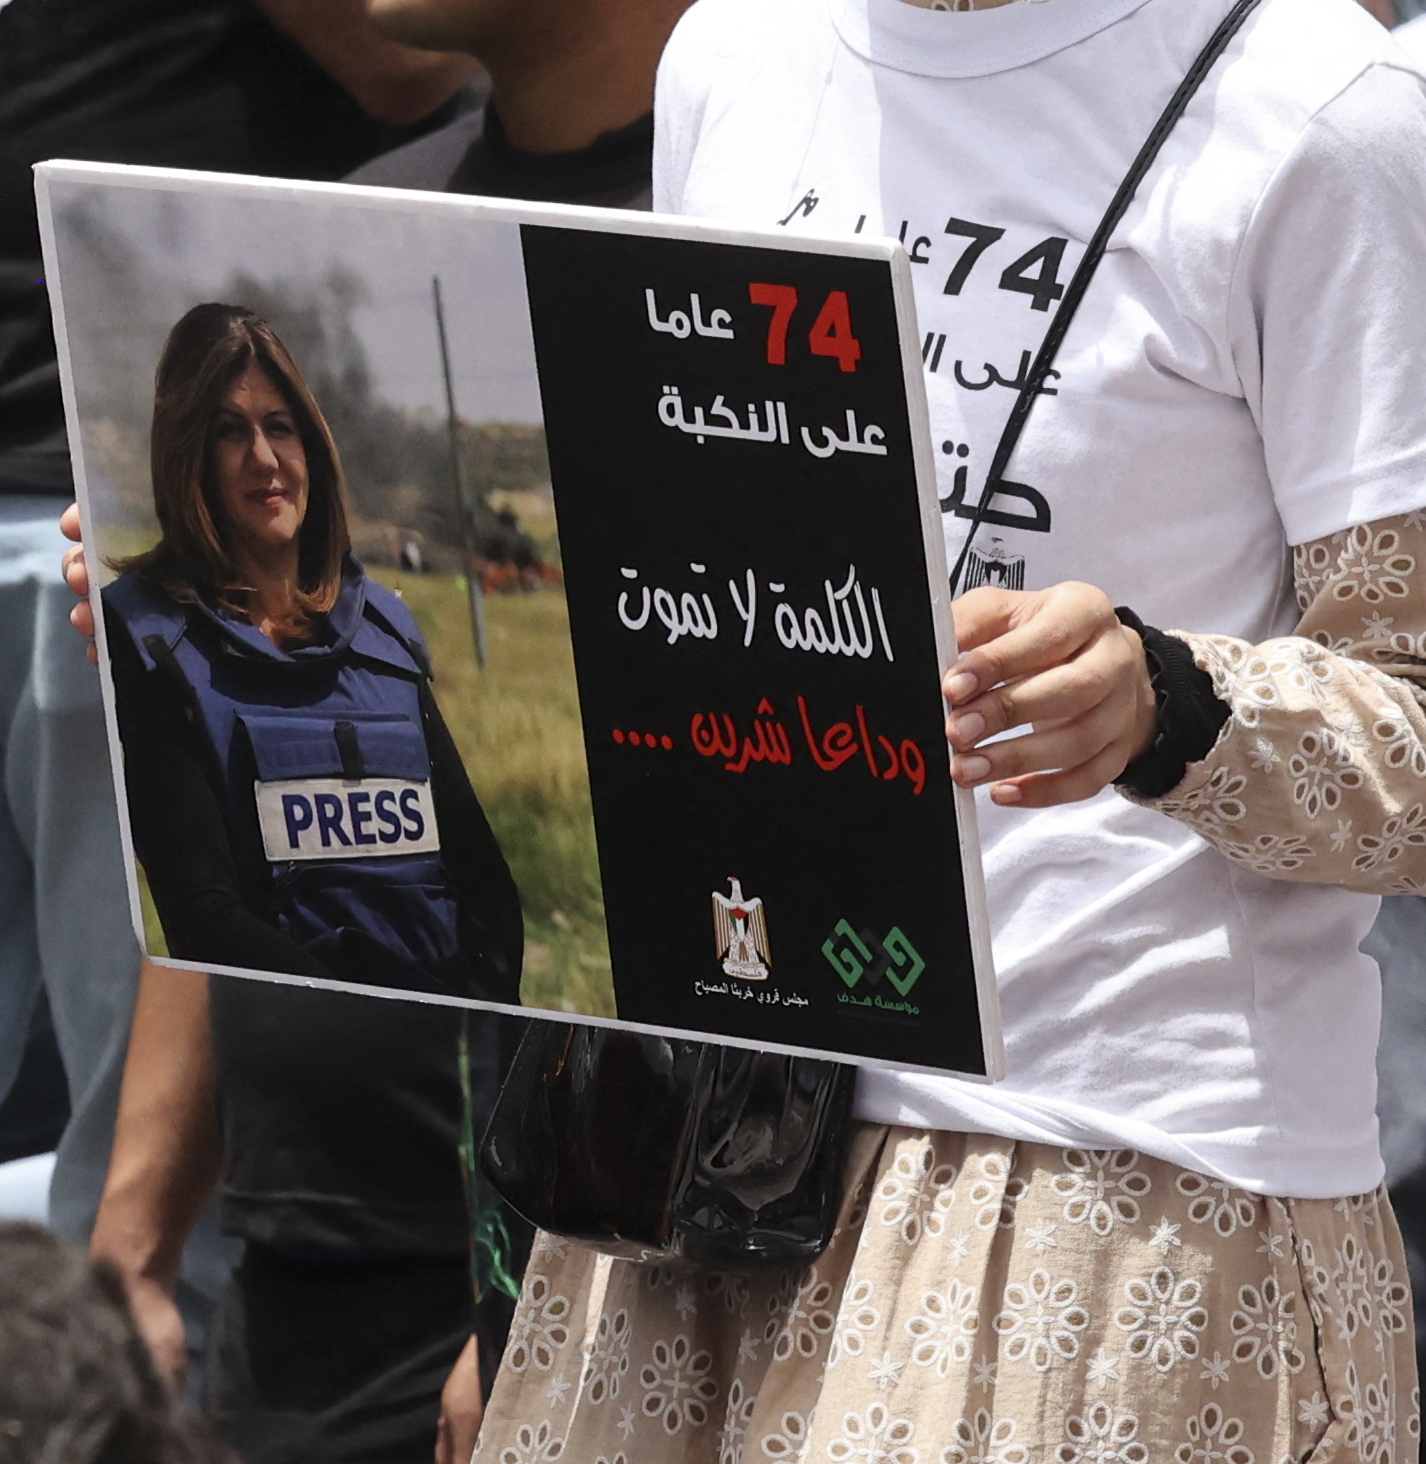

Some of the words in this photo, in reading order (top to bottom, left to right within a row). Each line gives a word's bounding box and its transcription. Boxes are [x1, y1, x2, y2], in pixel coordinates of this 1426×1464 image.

[943, 217, 1069, 312] 74
[646, 289, 734, 339] عاما
[750, 283, 861, 372] 74
[658, 386, 789, 444] النكبة
[801, 410, 887, 457] على
[618, 563, 717, 644] تموت
[729, 569, 755, 646] لا
[770, 564, 893, 661] الكلمة
[798, 697, 925, 794] وداعا
[281, 788, 425, 849] PRESS
[836, 991, 872, 1008] هدف
